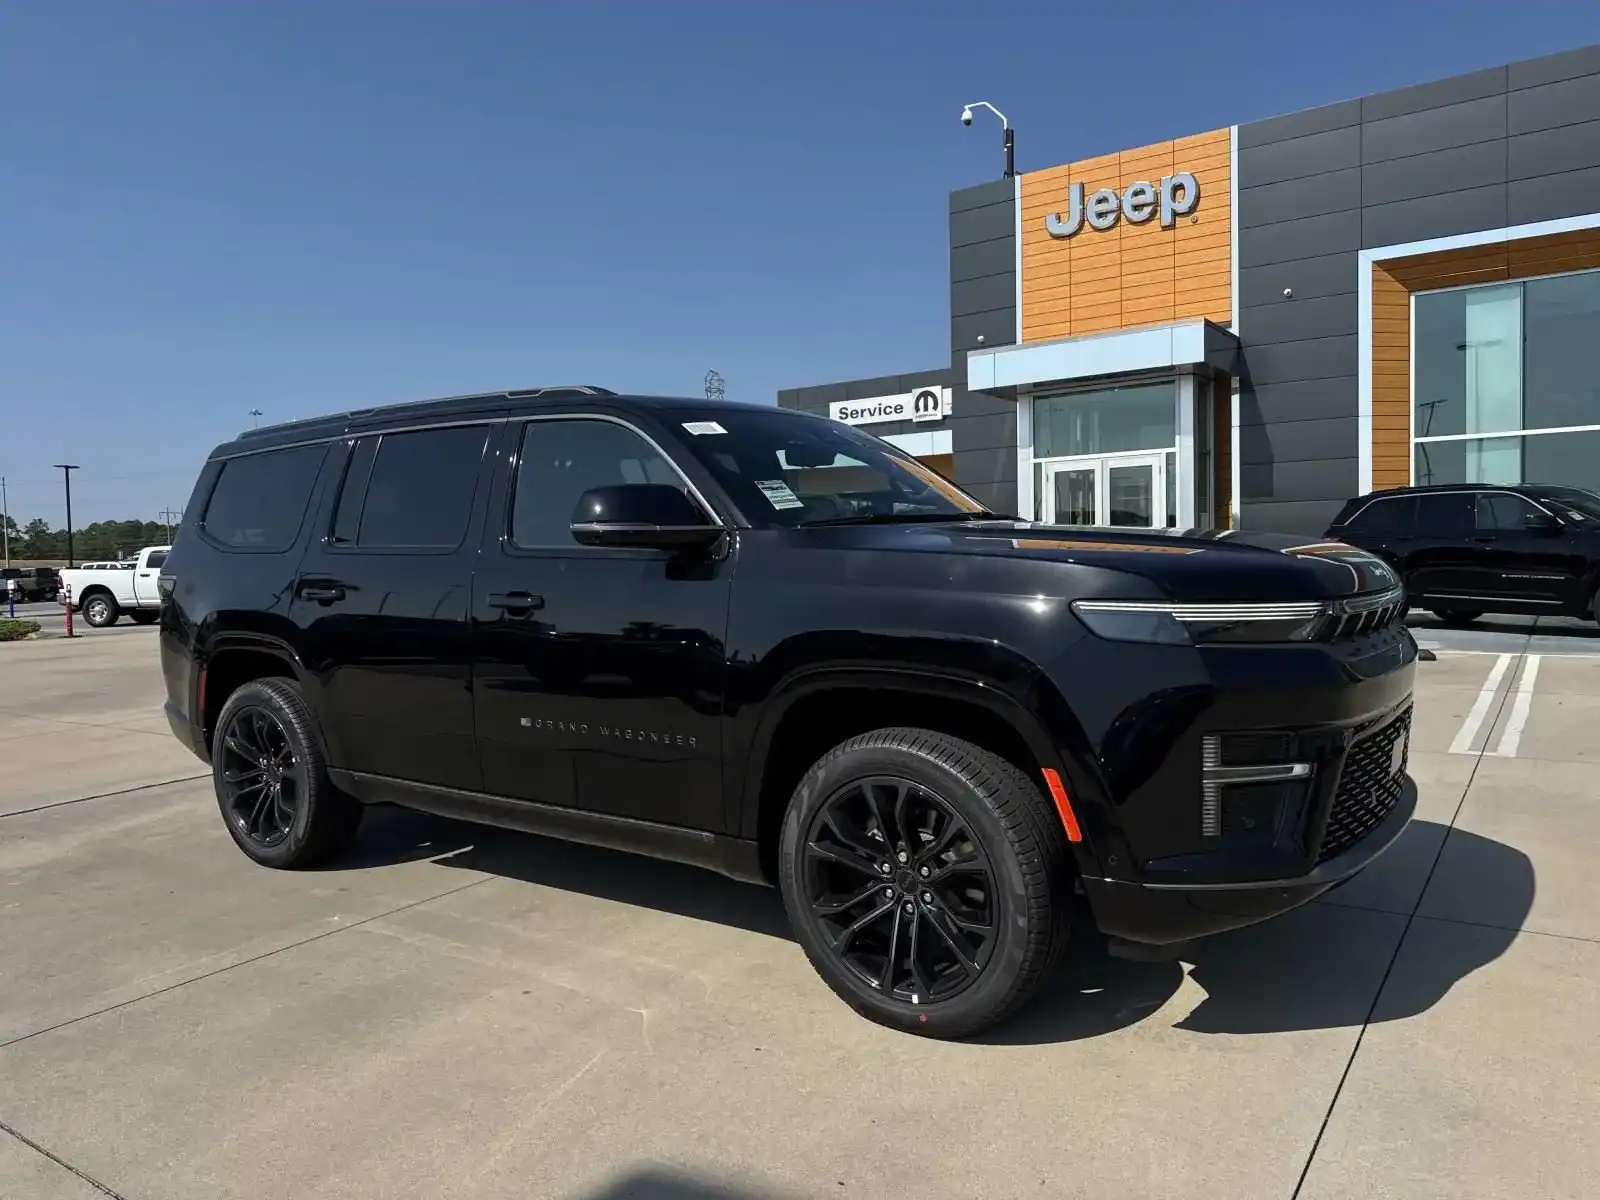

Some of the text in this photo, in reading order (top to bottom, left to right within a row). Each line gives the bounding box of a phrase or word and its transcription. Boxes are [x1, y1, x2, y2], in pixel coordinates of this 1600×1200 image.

[1045, 171, 1200, 239] Jeep
[839, 402, 904, 420] Service
[535, 718, 697, 748] GRAND WAGONEER
